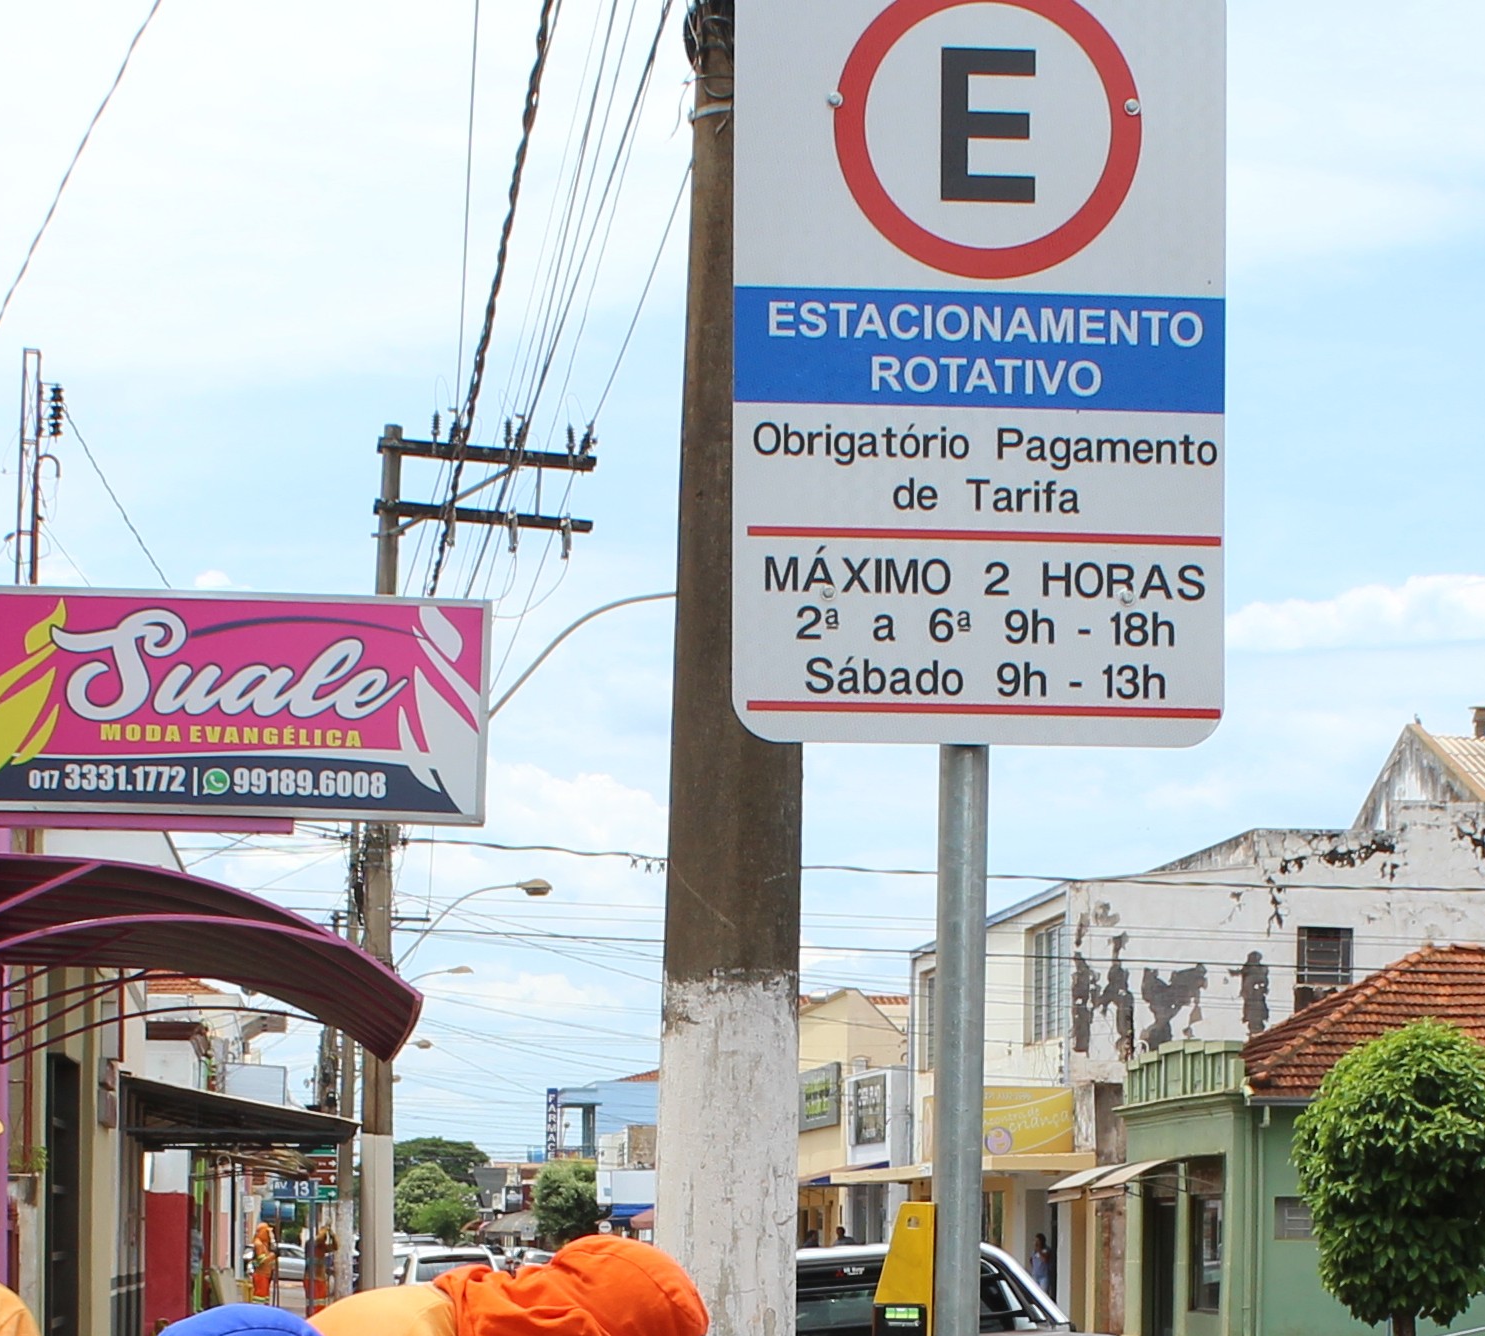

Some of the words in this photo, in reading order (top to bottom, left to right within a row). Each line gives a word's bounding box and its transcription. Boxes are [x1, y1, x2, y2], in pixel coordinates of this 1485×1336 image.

[940, 47, 1036, 204] E
[768, 301, 1204, 347] ESTACIONAMENTO
[871, 355, 1103, 396] ROTATIVO
[752, 421, 970, 466] Obrigatório
[996, 427, 1218, 470] Pagamento
[892, 477, 938, 510] de
[965, 478, 1080, 514] Tarifa
[764, 546, 951, 596] MÁXIMO
[984, 562, 1010, 596] 2
[1041, 561, 1206, 601] HORAS
[795, 605, 839, 640] 2ª
[872, 613, 896, 641] a
[929, 607, 971, 643] 6ª
[1004, 608, 1055, 645] 9h
[1110, 610, 1175, 647] 18h
[49, 607, 409, 721] Suale
[805, 655, 964, 696] Sábado
[996, 661, 1047, 698] 9h
[1102, 662, 1166, 699] 13h
[100, 723, 181, 743] MODA
[189, 725, 363, 748] EVANGÉLICA
[28, 769, 60, 791] 017
[64, 763, 185, 792] 3331.1772
[233, 767, 387, 799] 99189.6008
[294, 1180, 311, 1198] 13
